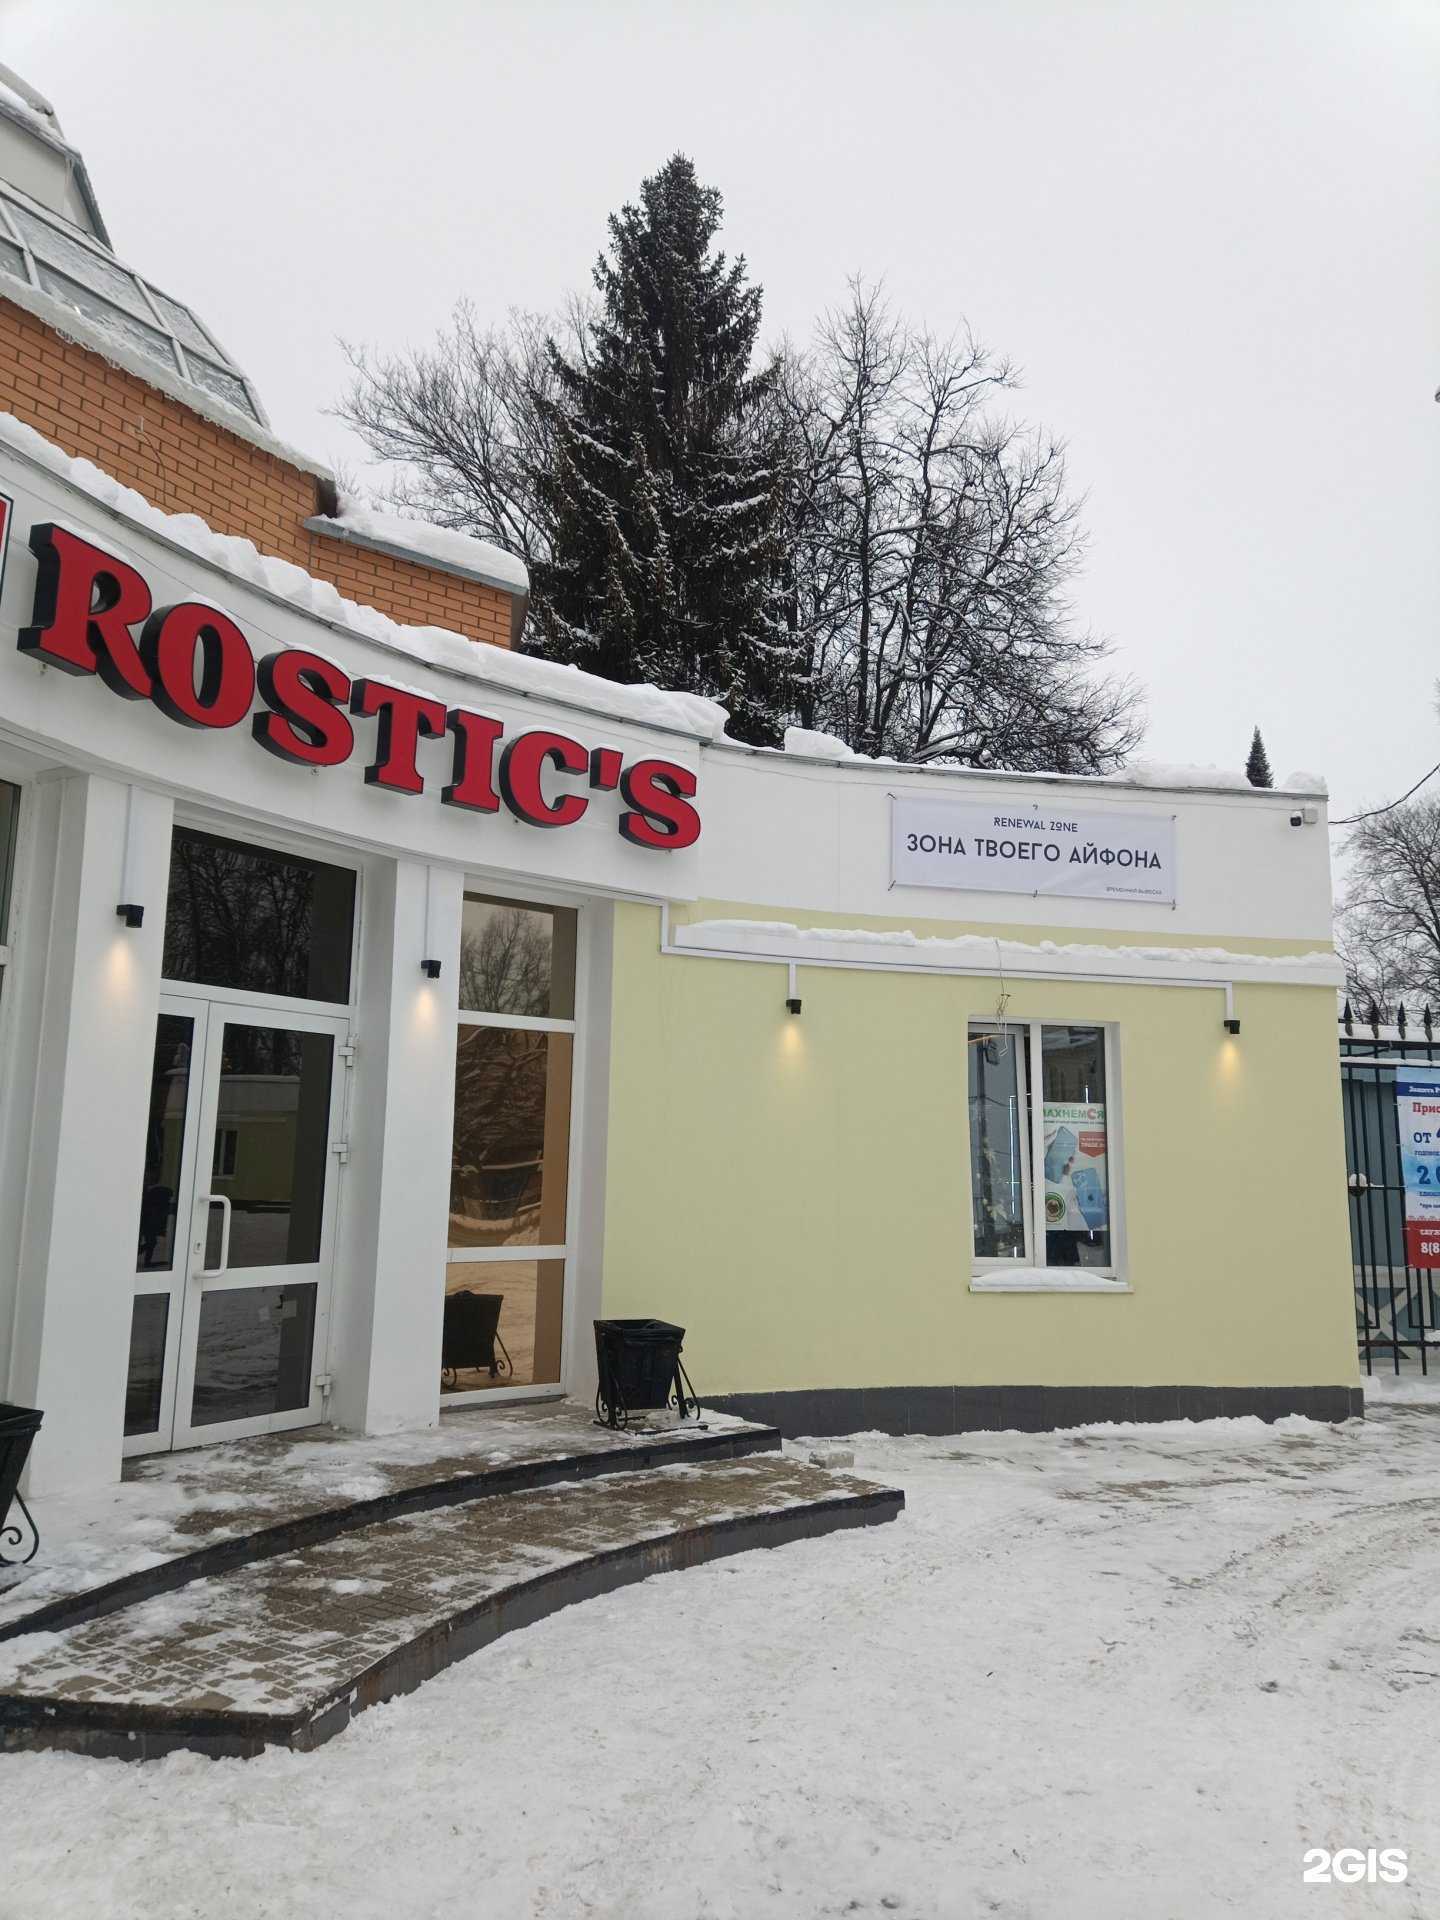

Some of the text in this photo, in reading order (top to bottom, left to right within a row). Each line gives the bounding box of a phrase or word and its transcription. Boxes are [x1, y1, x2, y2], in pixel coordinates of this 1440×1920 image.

[18, 522, 701, 850] ROSTIC'S
[993, 816, 1079, 833] RENEWAL ZONE
[906, 833, 1162, 869] ЗОНА ТВОЕГО АЙФОНА
